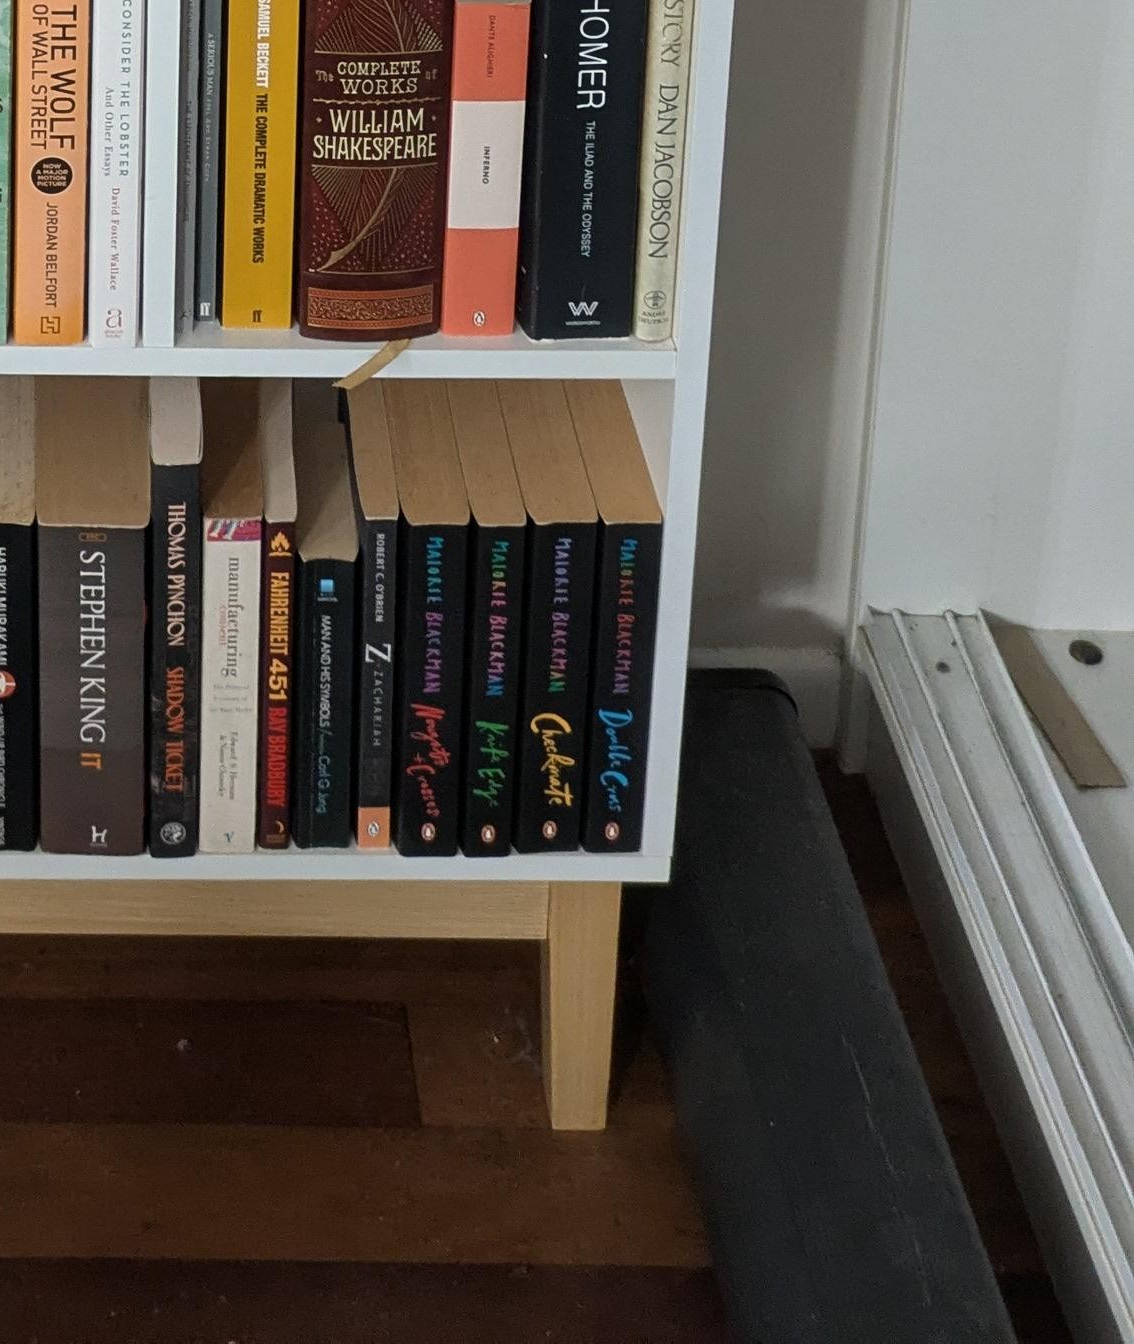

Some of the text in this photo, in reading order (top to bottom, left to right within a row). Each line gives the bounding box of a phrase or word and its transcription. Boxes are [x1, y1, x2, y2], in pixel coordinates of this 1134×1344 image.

[255, 43, 270, 89] BECKETT
[337, 60, 421, 75] COMPLETE
[313, 133, 437, 160] SHAKESPEARE
[329, 109, 424, 132] WILLIAM
[482, 145, 490, 185] INFERNO
[649, 141, 675, 259] JACOBSON
[44, 251, 58, 308] BELFORT
[166, 502, 186, 646] THOMAS PYNCHON
[78, 550, 106, 743] STEPHEN KING
[270, 572, 290, 701] FAHRENHEIT 451
[267, 734, 287, 808] BRADBURY
